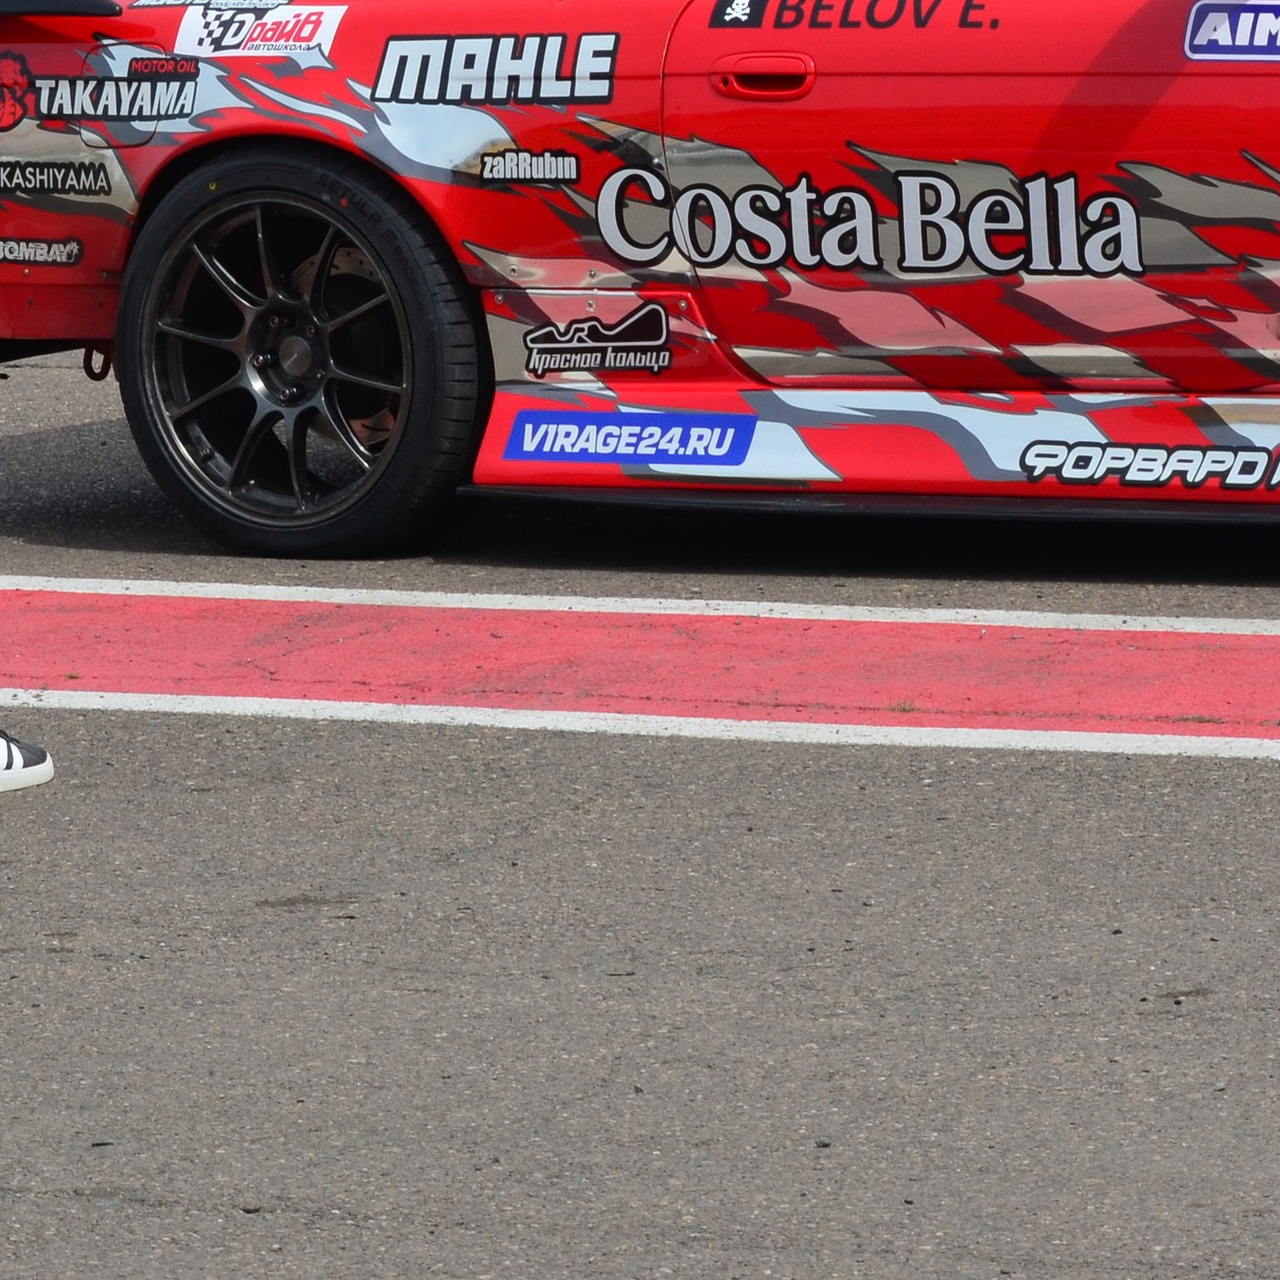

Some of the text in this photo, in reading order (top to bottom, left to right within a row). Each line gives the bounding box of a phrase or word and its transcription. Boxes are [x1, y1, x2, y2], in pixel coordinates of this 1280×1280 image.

[131, 60, 197, 74] MOTOR OIL
[375, 34, 617, 100] MAHLE
[36, 80, 198, 116] TAKAYAMA
[0, 166, 108, 191] KASHIYAMA
[598, 168, 1144, 273] Costa Bella
[522, 423, 735, 456] VIRAGE24.RU
